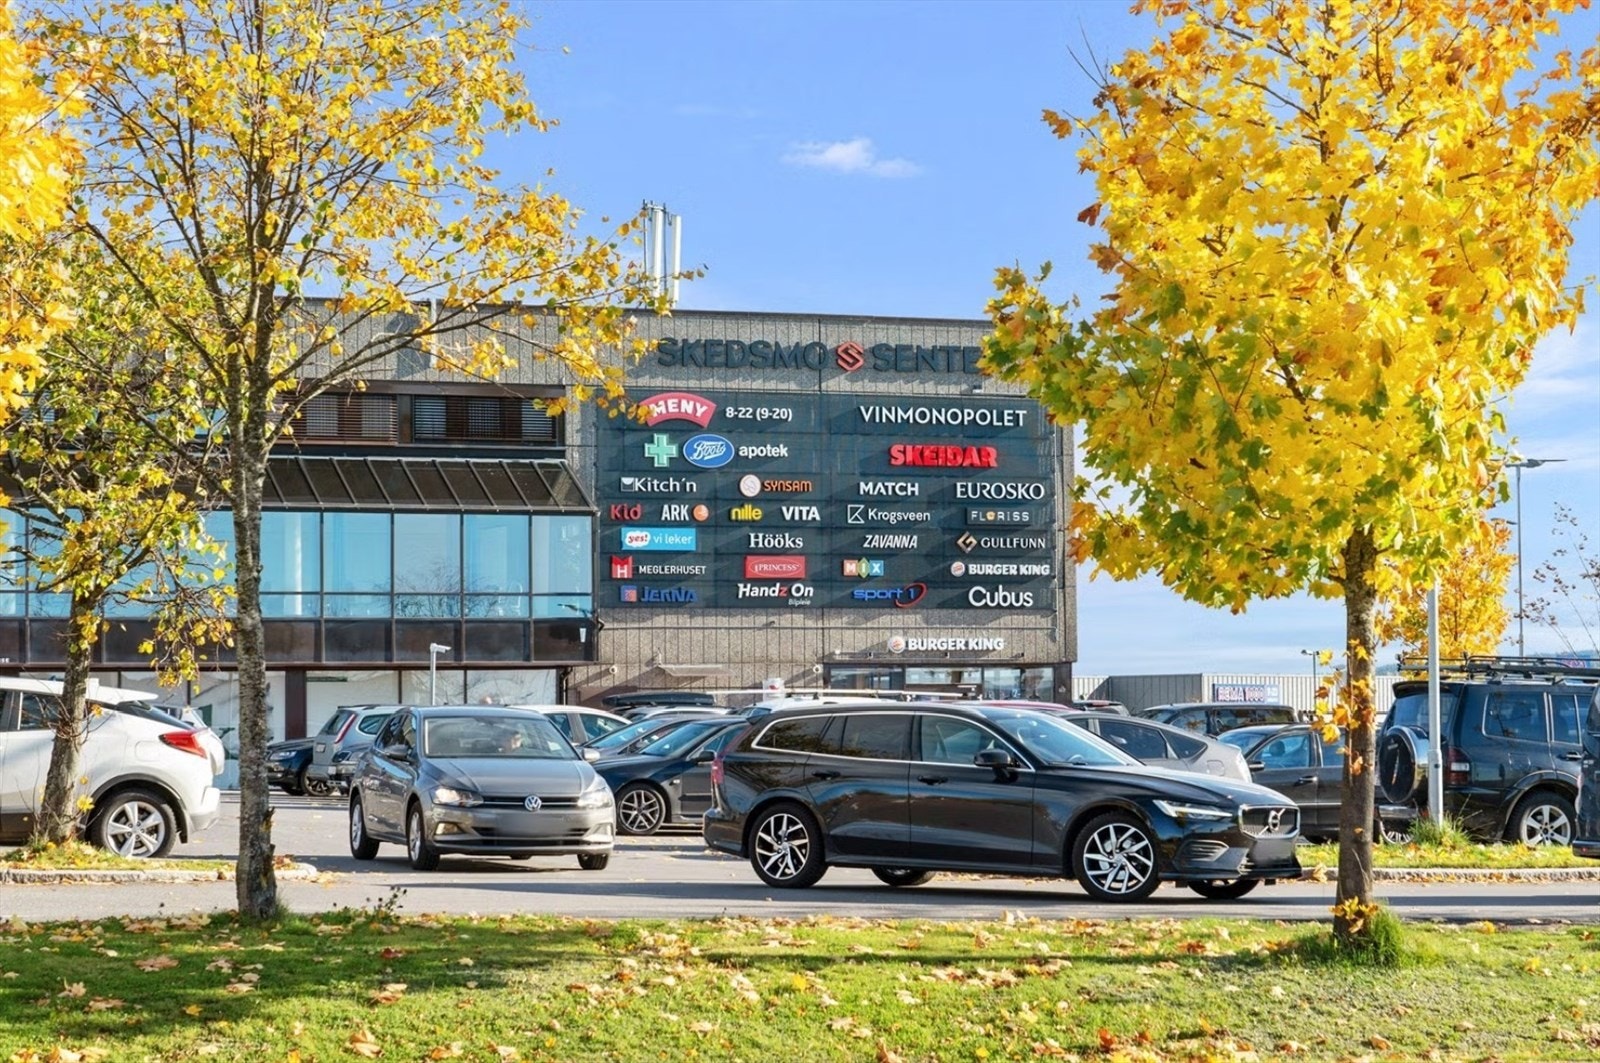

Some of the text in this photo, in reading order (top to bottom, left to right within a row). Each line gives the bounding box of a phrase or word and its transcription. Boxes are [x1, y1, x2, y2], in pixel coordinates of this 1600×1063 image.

[657, 337, 829, 370] SKEDSMO
[872, 343, 982, 373] SENTE
[649, 399, 708, 417] MENY
[725, 407, 792, 422] 8-22 (9-20)
[860, 406, 1027, 427] VINMONOPOLET
[690, 440, 726, 460] Boots
[738, 444, 788, 459] apotek
[890, 444, 998, 468] SKEIDAR
[763, 480, 812, 492] SYNSAM
[859, 482, 919, 496] MATCH
[956, 482, 1045, 500] EUROSKO
[610, 504, 643, 520] Kid
[661, 504, 689, 521] ARK
[731, 504, 762, 520] nille
[782, 506, 821, 521] VITA
[868, 508, 931, 524] Krogsveen
[971, 511, 1030, 522] FLORISS
[627, 534, 649, 544] yes!
[654, 535, 693, 544] vi leker
[749, 532, 803, 548] Hööks
[863, 534, 918, 549] ZAVANNA
[980, 537, 1046, 549] GULLFUNN
[639, 565, 707, 575] MEGLERHUSET
[757, 564, 798, 572] PRINCESS
[845, 561, 882, 574] MIX
[968, 563, 1050, 576] BURGER KING
[737, 582, 814, 599] Handz On
[853, 588, 916, 601] sport 1
[968, 584, 1034, 607] Cubus
[908, 637, 1005, 651] BURGER KING
